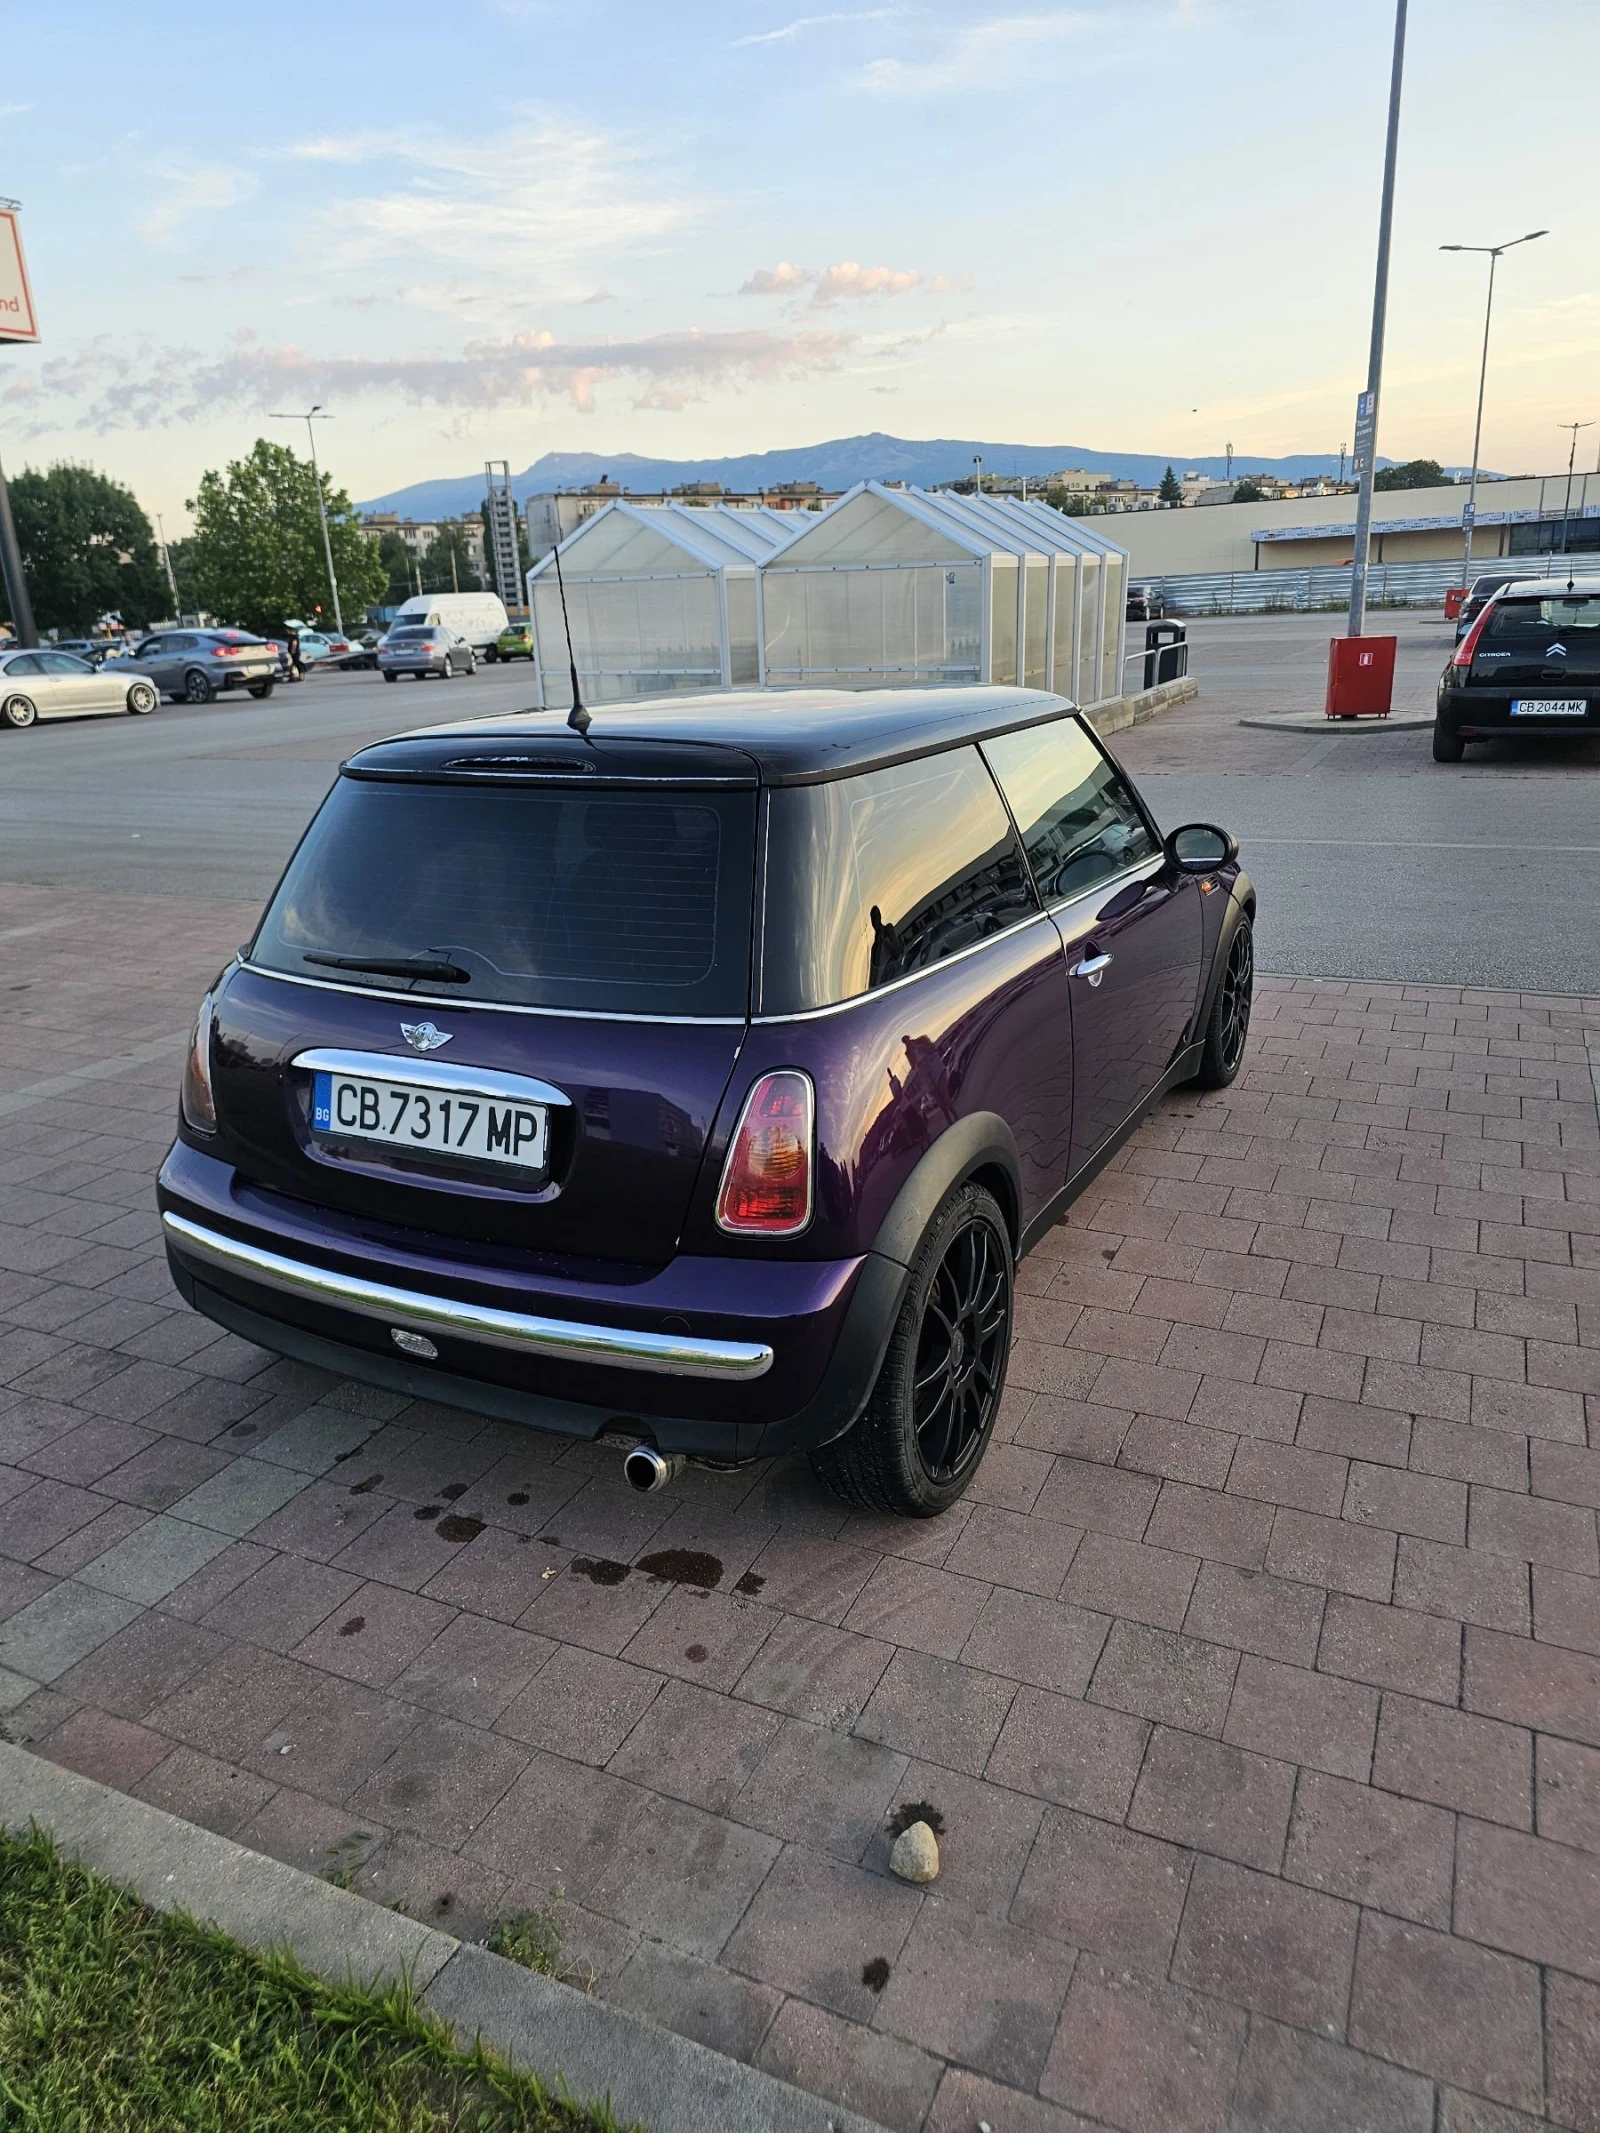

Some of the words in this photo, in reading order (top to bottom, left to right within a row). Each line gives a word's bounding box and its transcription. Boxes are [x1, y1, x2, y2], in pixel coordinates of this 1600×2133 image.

[1519, 702, 1534, 713] CB
[1537, 702, 1566, 713] 2044
[1567, 702, 1584, 713] MK
[316, 1107, 330, 1122] BG
[336, 1083, 380, 1131] CB
[389, 1092, 480, 1148] 7317
[487, 1106, 538, 1157] MP
